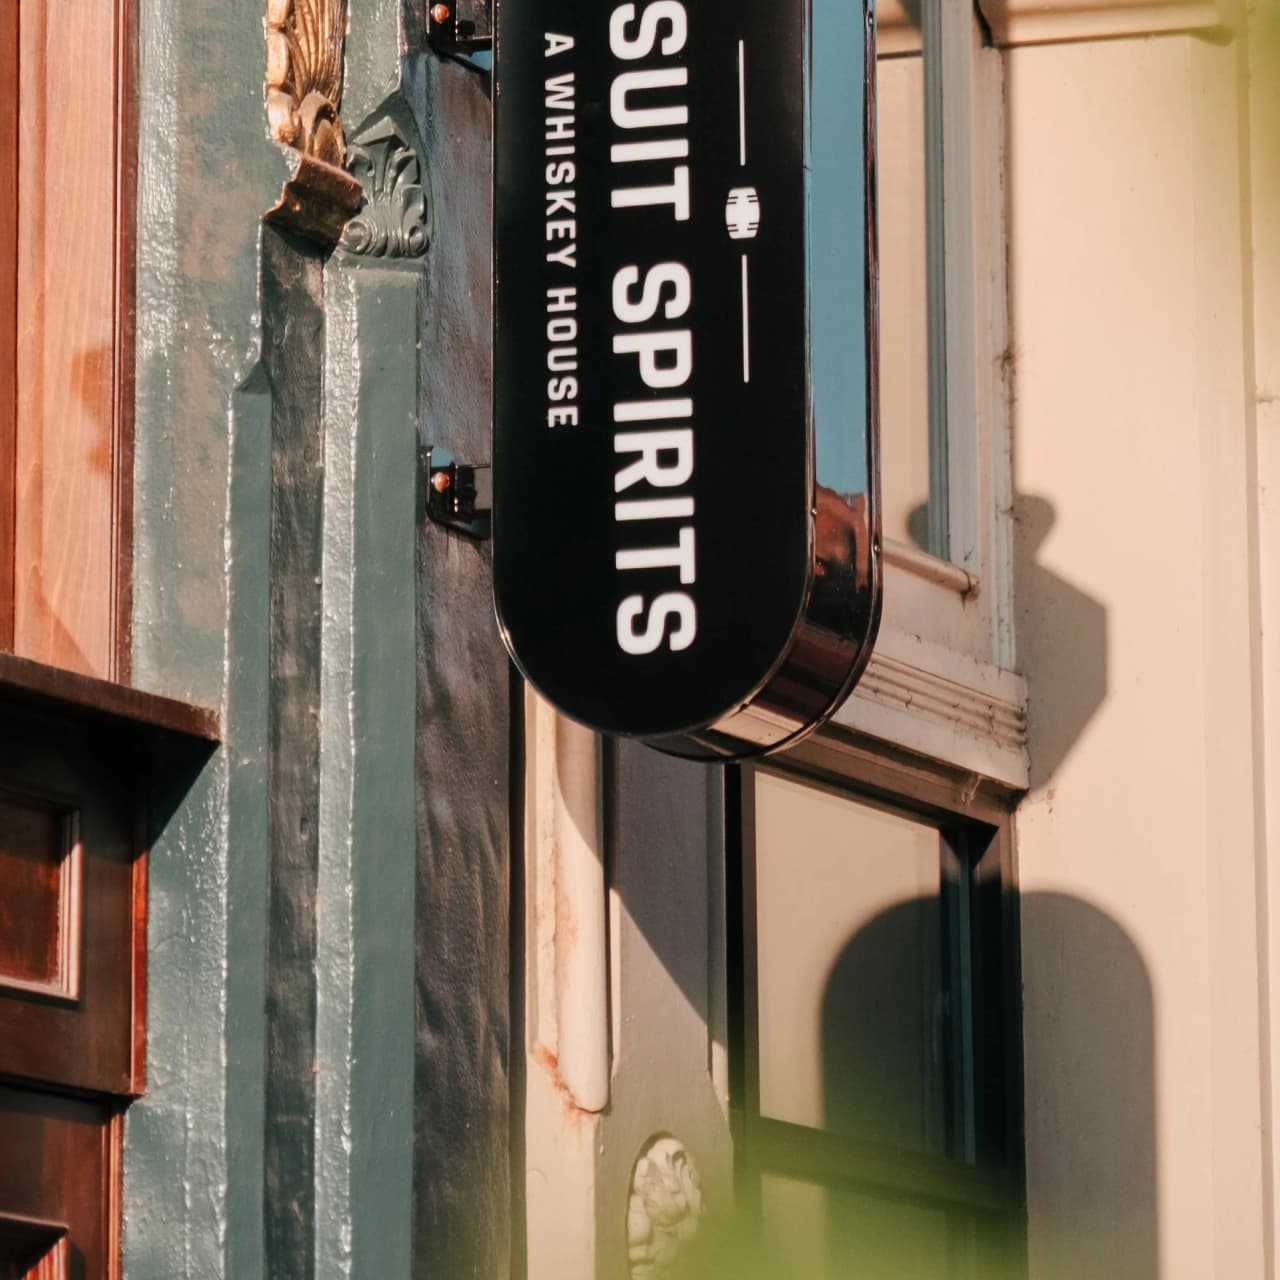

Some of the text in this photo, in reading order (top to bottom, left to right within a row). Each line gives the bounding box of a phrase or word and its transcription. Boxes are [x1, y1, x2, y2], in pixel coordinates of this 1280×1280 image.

[544, 32, 579, 428] A WHISKEY HOUSE
[611, 261, 697, 655] SPIRITS
